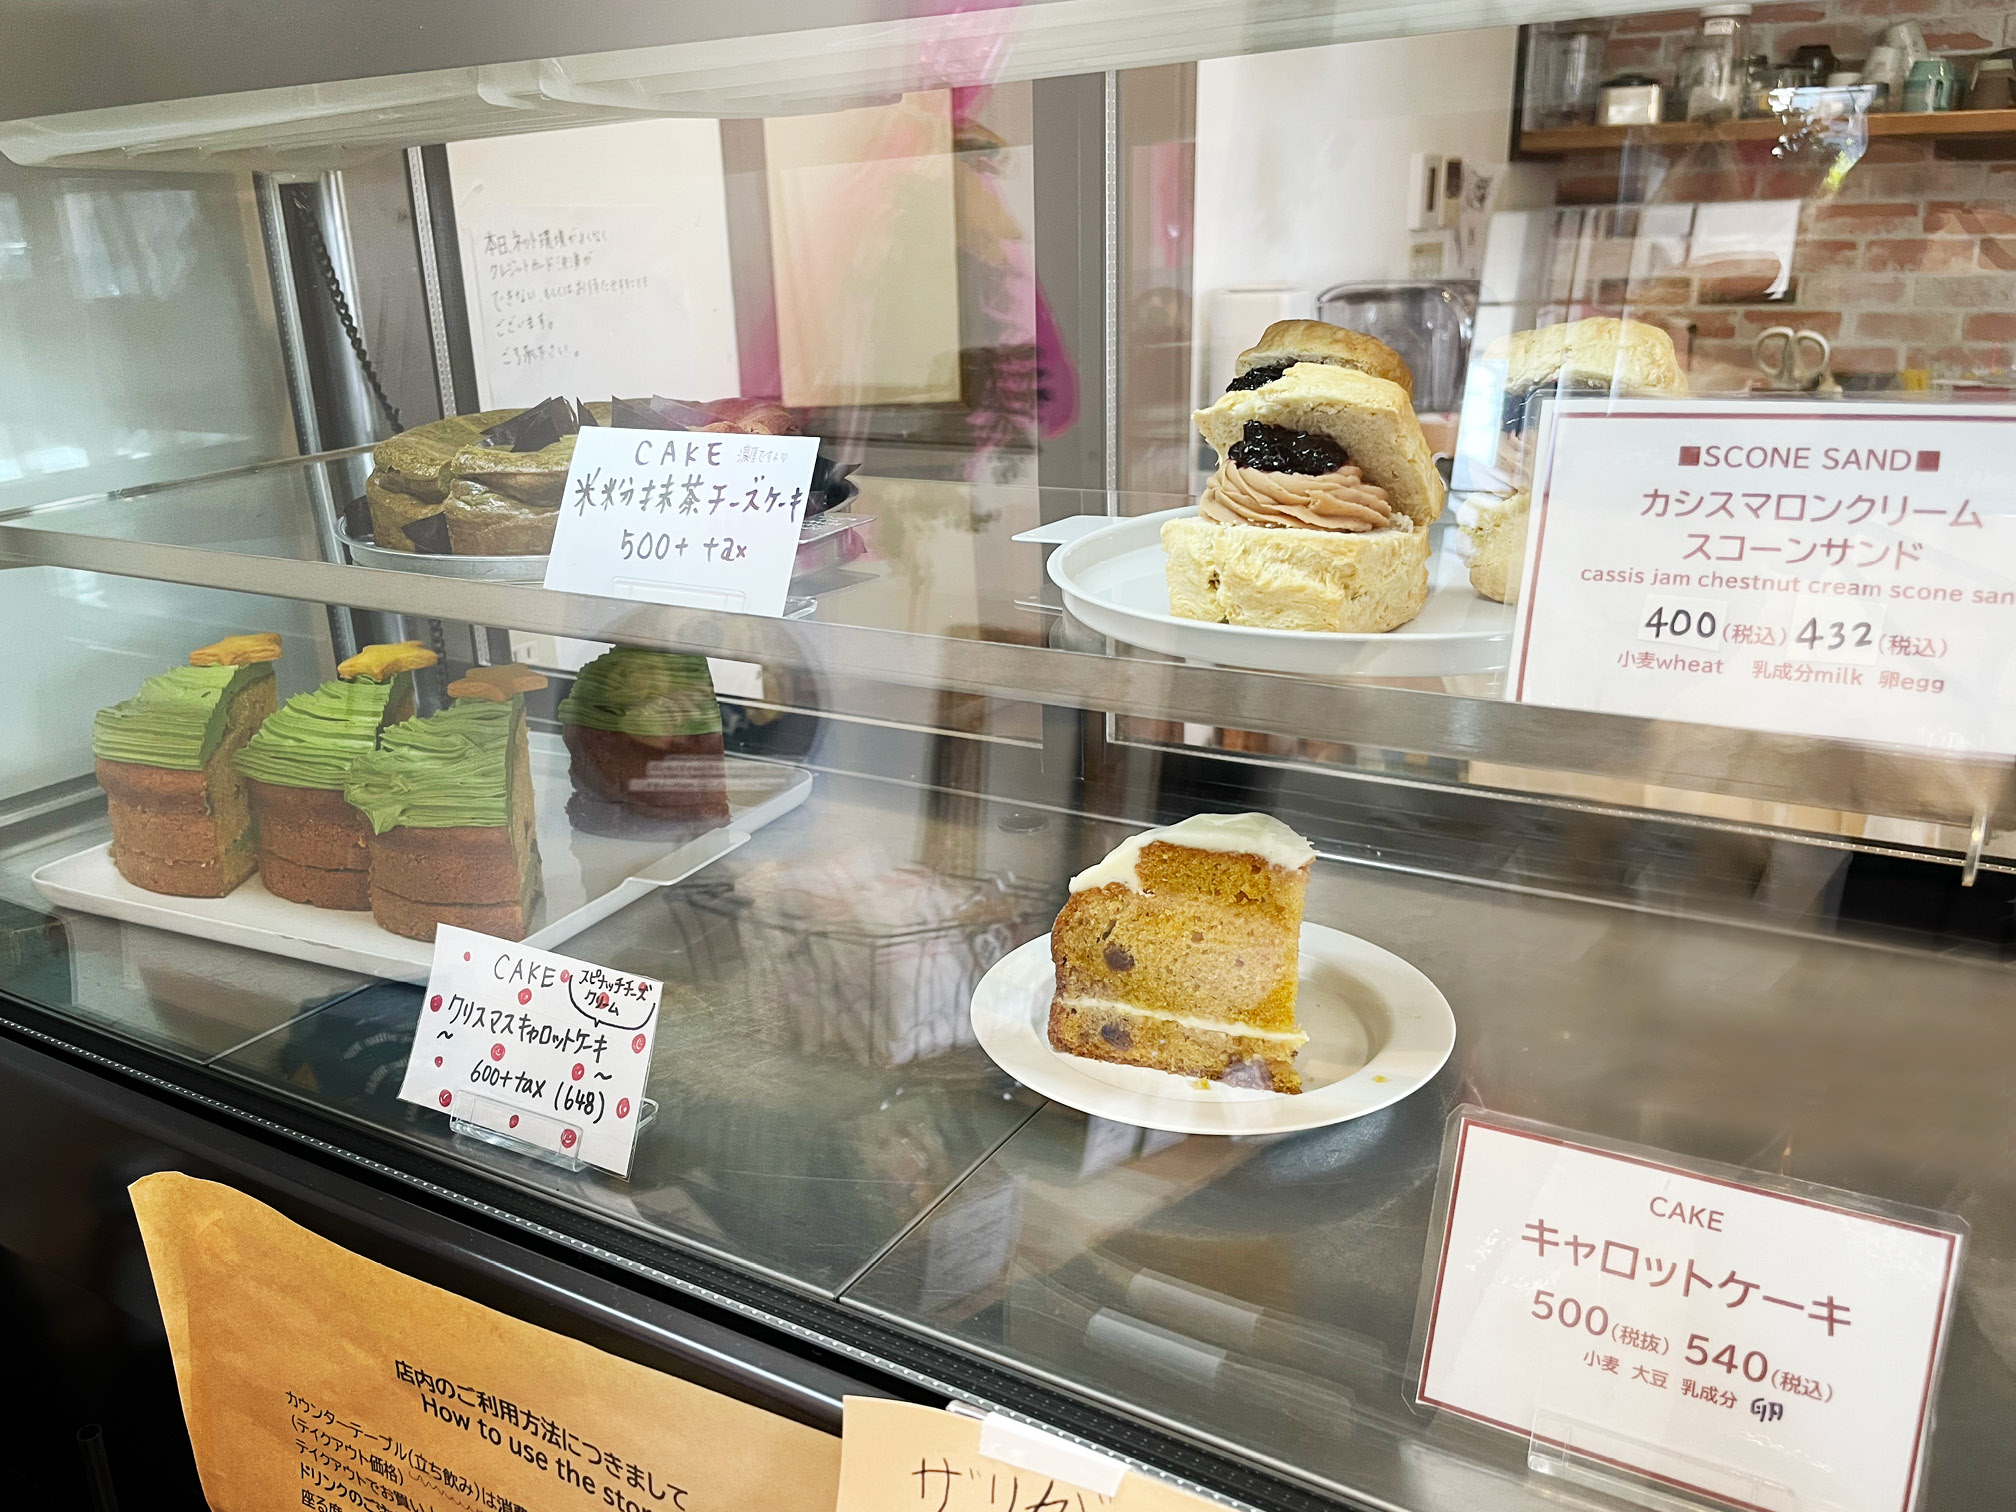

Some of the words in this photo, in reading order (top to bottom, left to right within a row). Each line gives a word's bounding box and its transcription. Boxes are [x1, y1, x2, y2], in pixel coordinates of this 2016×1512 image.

[634, 439, 723, 467] CAKE
[1703, 445, 1811, 470] SCONE
[1822, 447, 1912, 472] SAND
[574, 466, 804, 523] 米粉抹茶チーズケーキ
[1640, 488, 1984, 530] カシスマロンクリーム
[1682, 533, 1924, 571] スコーンサンド
[1580, 567, 1645, 584] cassis
[1650, 568, 1691, 587] jam
[1697, 571, 1801, 593] chestnut
[1807, 579, 1882, 597] cream
[1889, 584, 1963, 604] scone
[1616, 650, 1725, 675] 小麦wheat
[1751, 660, 1865, 686] 乳成分milk
[1877, 670, 1946, 695] 卵egg
[493, 953, 557, 988] CAKE
[447, 993, 608, 1064] クリスマスキャロットケーキ
[553, 1081, 606, 1125] (648)
[1648, 1196, 1725, 1233] CAKE
[1520, 1218, 1852, 1337] キャロットケーキ
[1583, 1350, 1620, 1375] 小麦
[1631, 1365, 1669, 1390] 大豆
[1681, 1378, 1738, 1409] 乳成分
[395, 1359, 689, 1511] 店内のご利用方法につきまして
[421, 1393, 471, 1431] How
[477, 1418, 502, 1446] to
[509, 1436, 549, 1471] use
[556, 1457, 597, 1495] the
